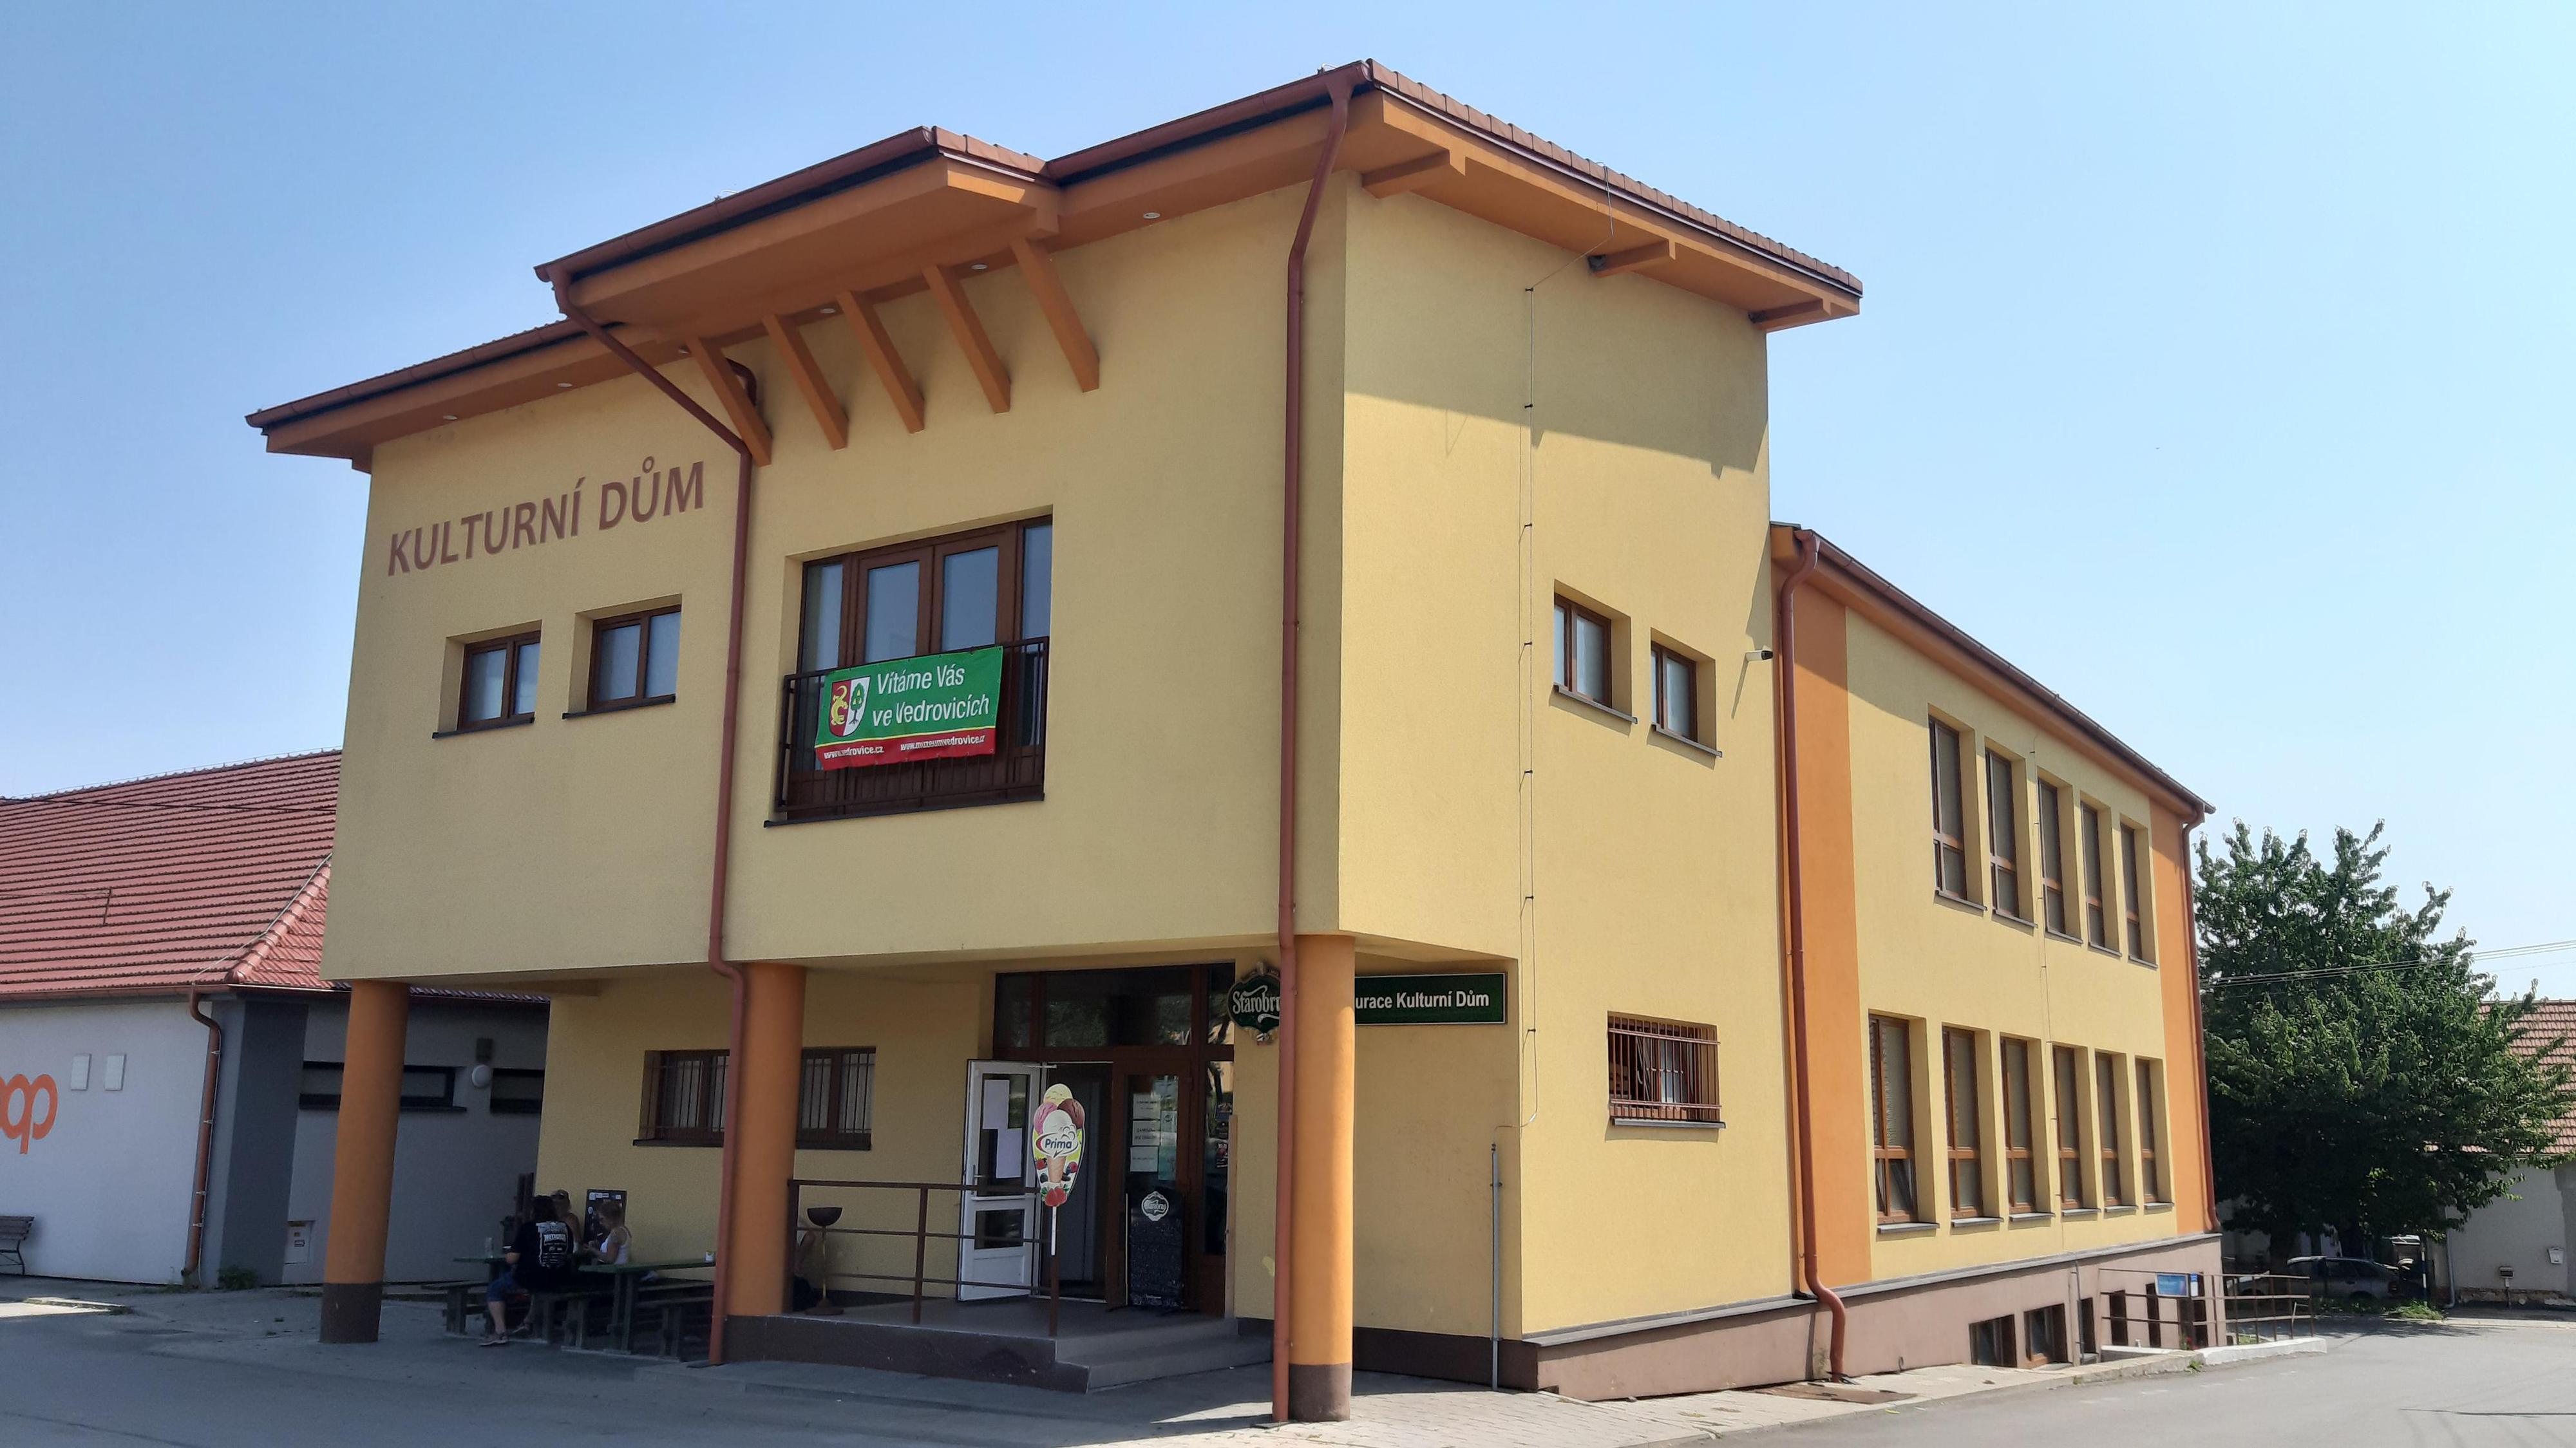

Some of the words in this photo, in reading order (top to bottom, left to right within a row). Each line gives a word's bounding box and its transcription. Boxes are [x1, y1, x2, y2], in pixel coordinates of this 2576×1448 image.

[388, 476, 586, 576] KULTURNÍ
[598, 456, 704, 531] DŮM
[877, 669, 932, 695] Vítáme
[937, 664, 965, 688] Vás
[873, 709, 893, 727] ve
[896, 694, 989, 724] Vedrovicích
[1396, 991, 1452, 1008] Kulturní
[1456, 990, 1490, 1008] Dům
[1045, 1138, 1072, 1149] Prima
